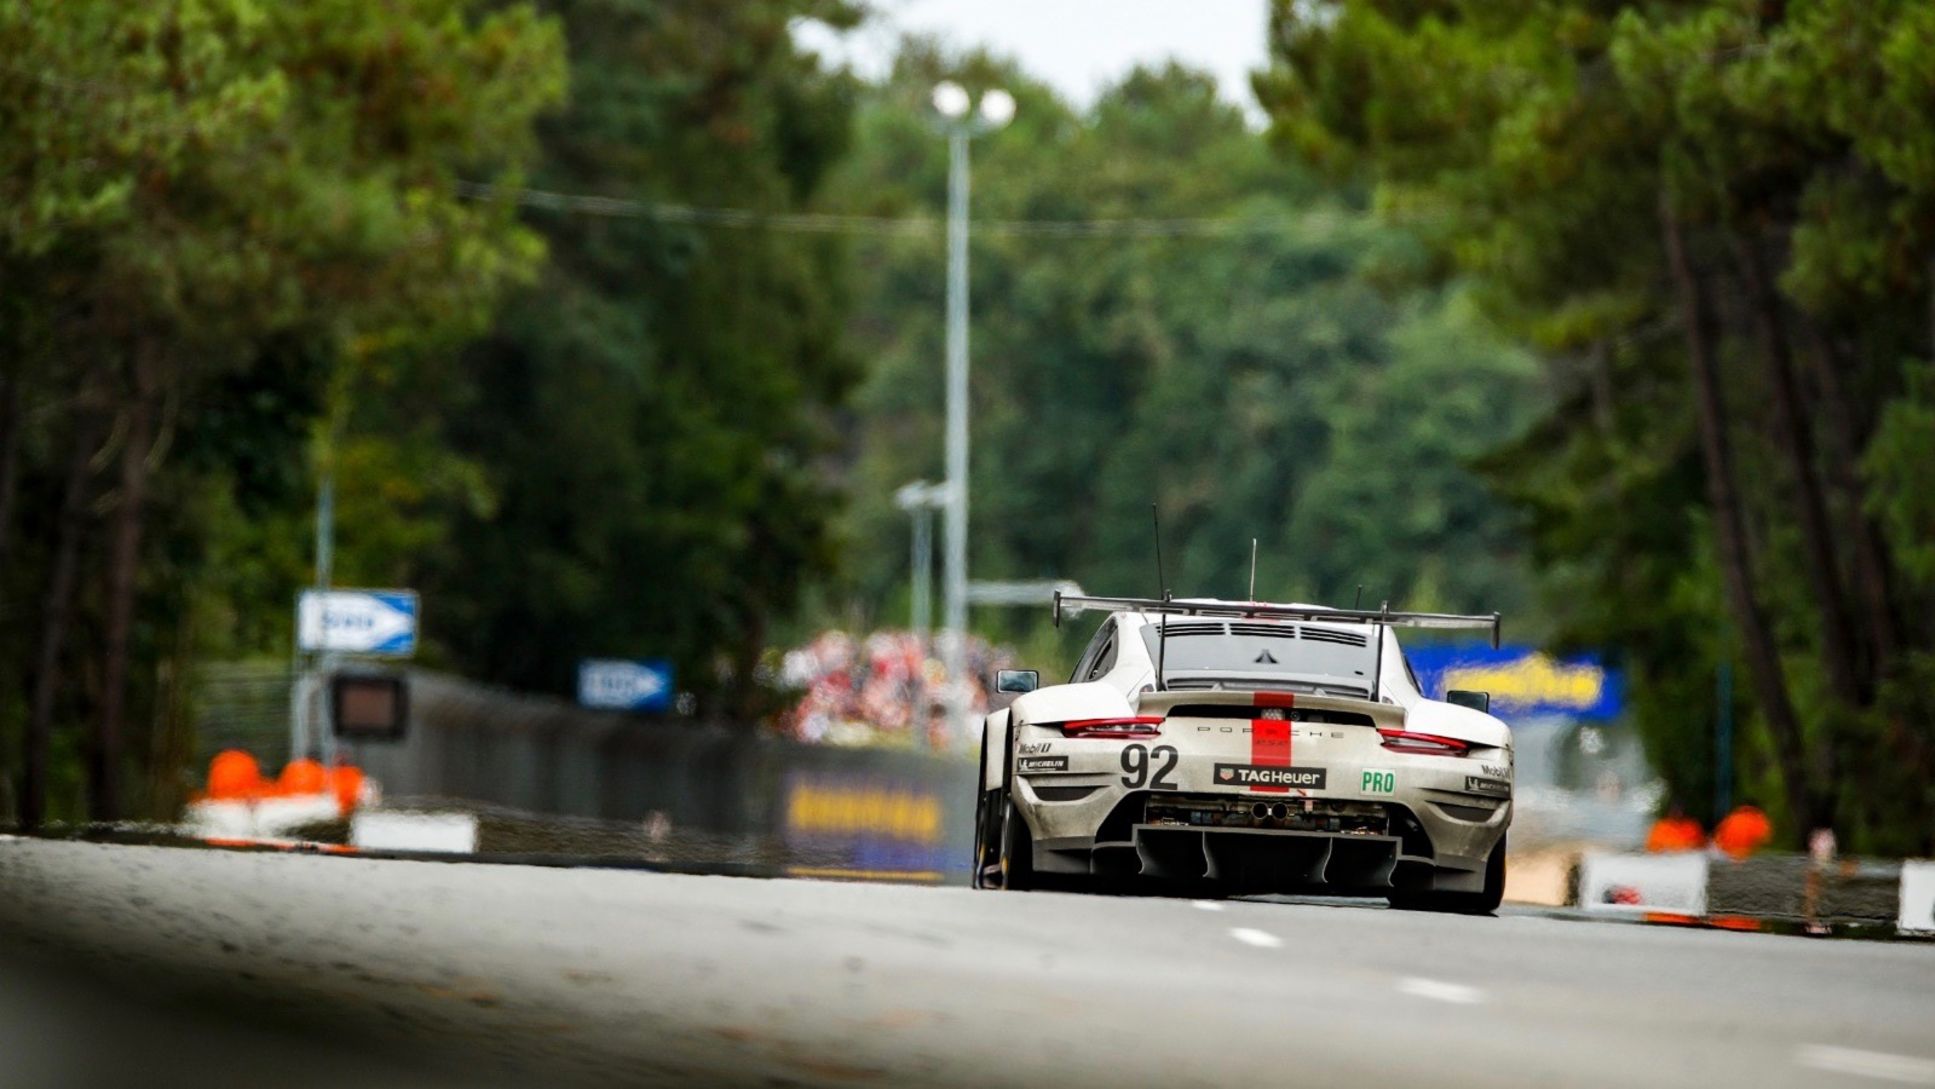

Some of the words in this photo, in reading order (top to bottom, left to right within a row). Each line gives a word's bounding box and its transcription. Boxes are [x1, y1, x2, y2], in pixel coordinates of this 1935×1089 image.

[1121, 743, 1179, 790] 92
[1238, 769, 1321, 784] TAGHeuer
[1362, 771, 1394, 793] PRO
